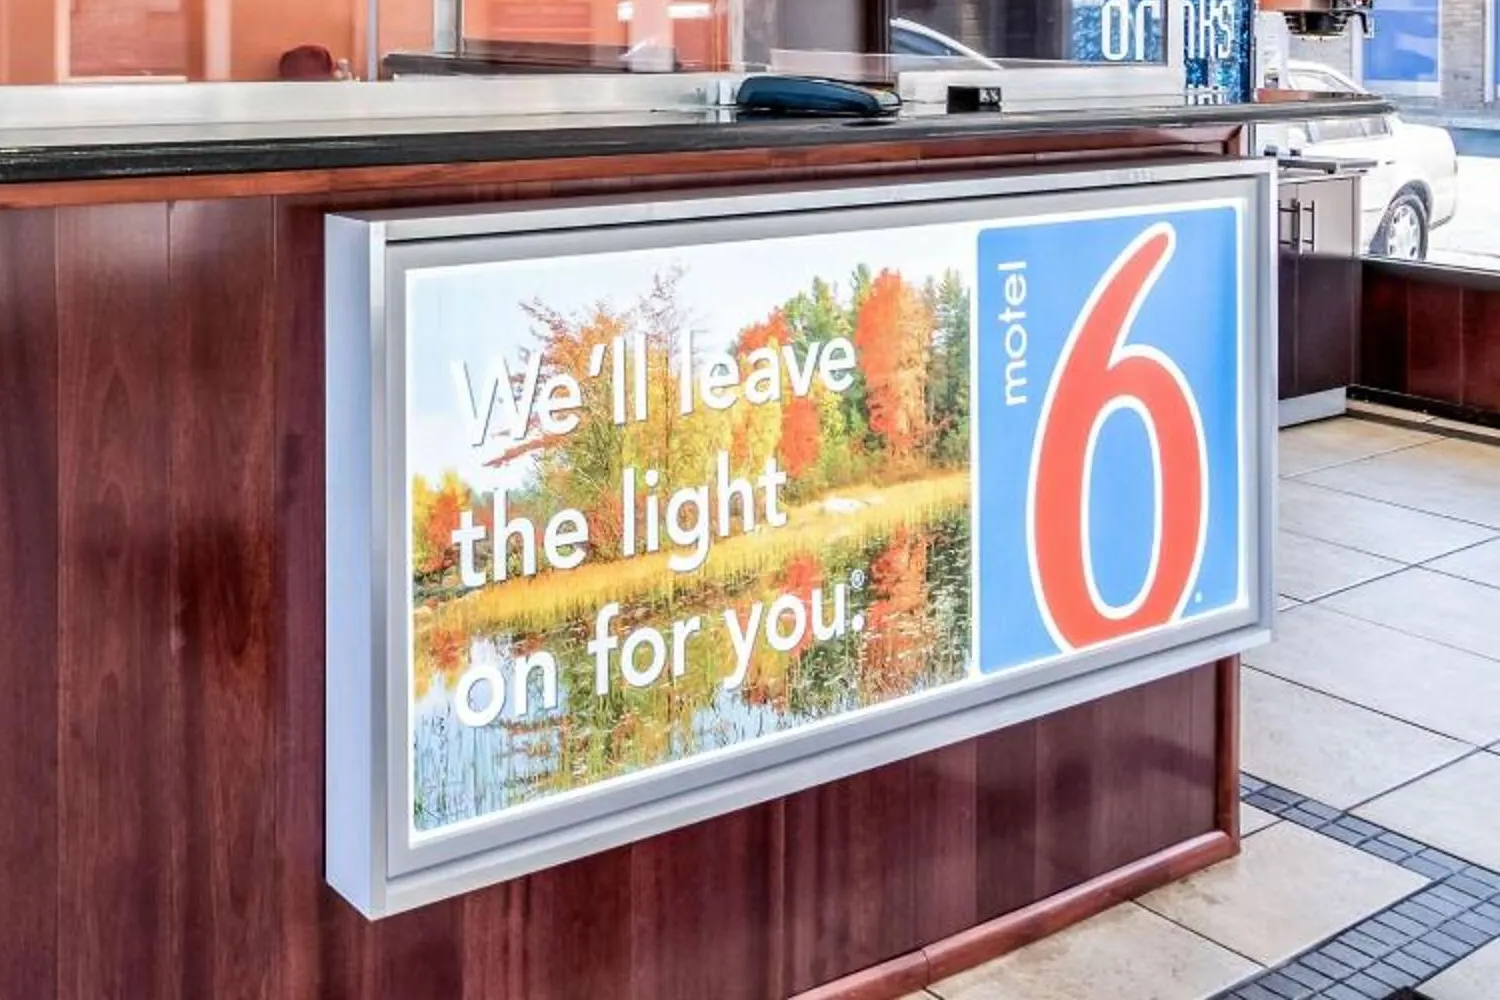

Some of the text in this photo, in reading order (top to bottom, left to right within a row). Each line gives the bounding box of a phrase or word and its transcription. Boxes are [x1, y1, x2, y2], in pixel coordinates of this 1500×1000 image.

[680, 329, 857, 416] leave
[998, 221, 1209, 655] motel 6
[451, 450, 789, 588] the light
[455, 649, 558, 727] on
[588, 602, 700, 695] for
